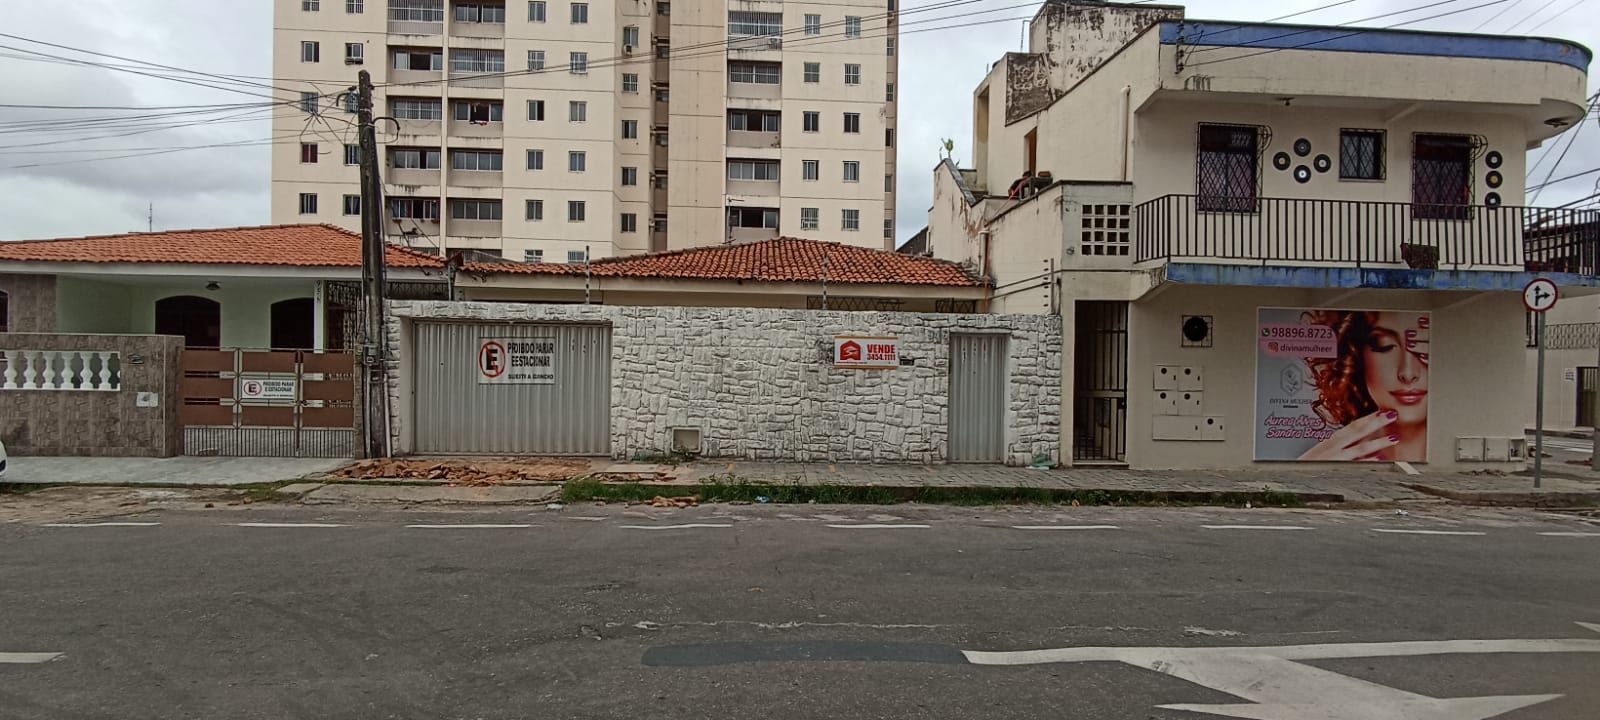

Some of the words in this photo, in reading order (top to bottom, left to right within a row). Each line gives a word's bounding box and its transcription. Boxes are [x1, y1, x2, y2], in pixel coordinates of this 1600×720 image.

[1271, 327, 1333, 339] 98896.8723
[867, 344, 895, 353] VENDE
[1280, 343, 1333, 353] divinamulheer
[486, 348, 499, 370] E
[1294, 414, 1322, 427] Alves
[1266, 427, 1302, 438] Sandra
[1303, 427, 1333, 442] Braga
